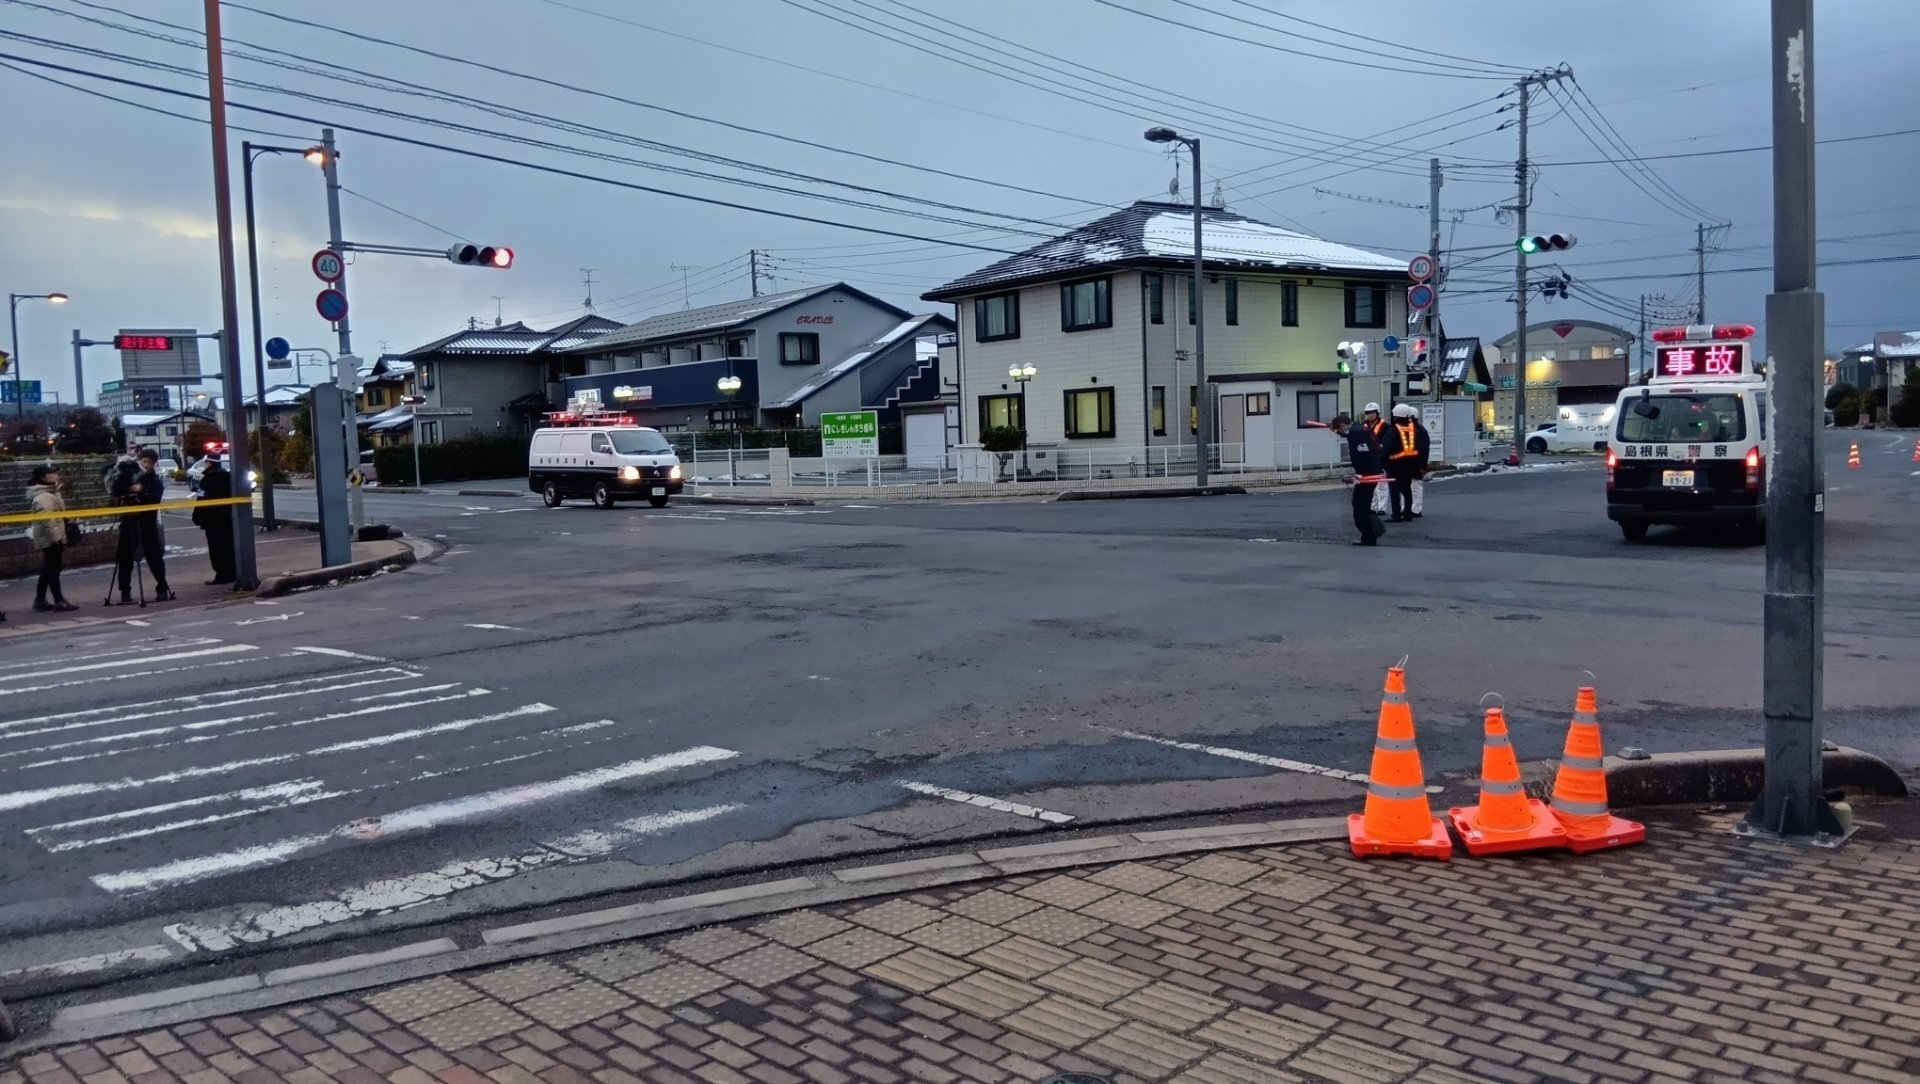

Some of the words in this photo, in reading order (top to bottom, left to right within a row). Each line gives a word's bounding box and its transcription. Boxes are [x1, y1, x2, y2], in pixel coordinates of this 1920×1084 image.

[320, 259, 338, 274] 40
[1414, 262, 1428, 274] 40
[796, 315, 834, 325] CRADLE
[1665, 345, 1735, 376] 事故
